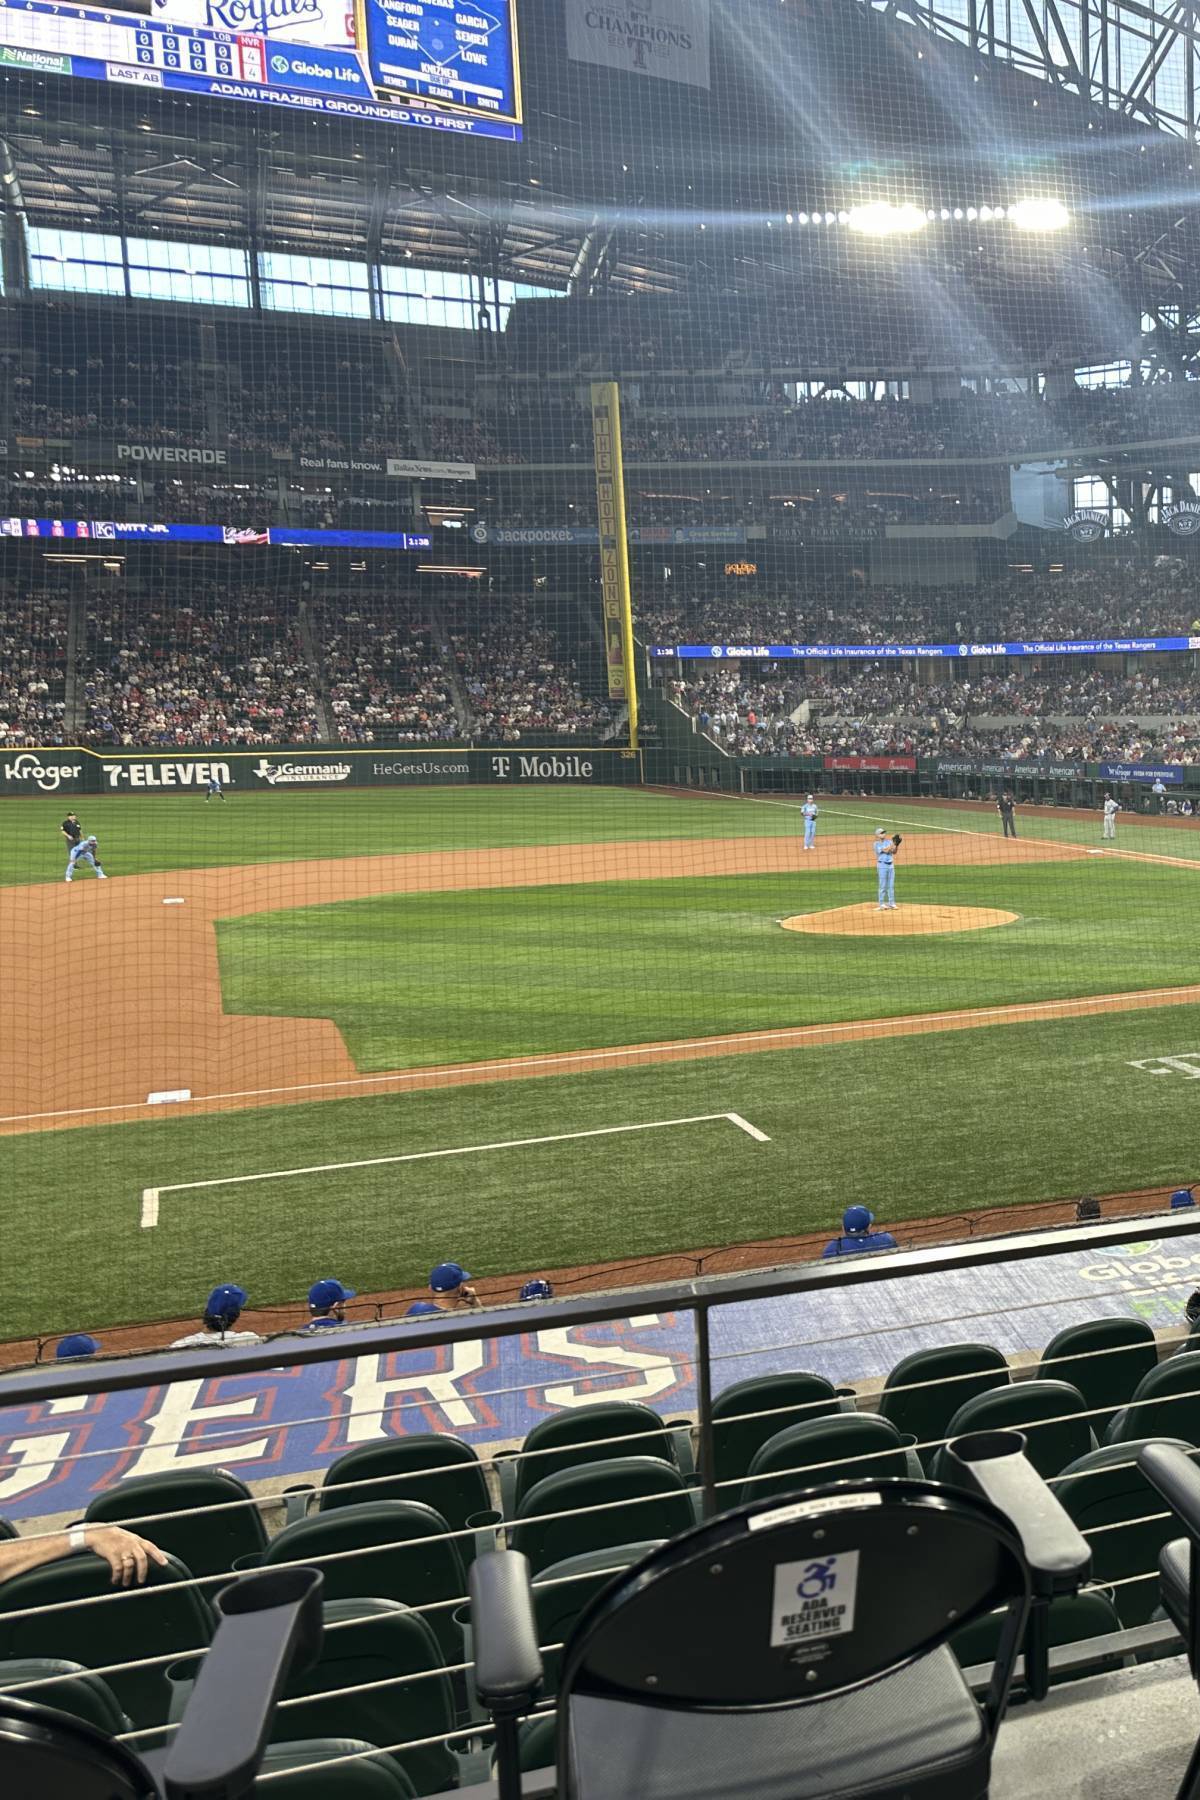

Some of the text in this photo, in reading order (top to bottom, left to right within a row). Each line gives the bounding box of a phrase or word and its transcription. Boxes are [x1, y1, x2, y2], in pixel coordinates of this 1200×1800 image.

[386, 15, 420, 32] SEAGER
[455, 13, 488, 30] GARCIA
[140, 20, 147, 28] R
[166, 24, 173, 33] H
[193, 29, 199, 37] E
[213, 32, 231, 42] LOB
[585, 11, 692, 50] CHAMPIONS
[388, 34, 418, 51] DURAN
[16, 51, 64, 66] National
[461, 50, 488, 66] LOWE
[110, 68, 159, 83] LAST AB
[291, 60, 360, 83] Globe Life
[210, 82, 474, 130] ADAM FRAZIER GROUNDED TO FIRST
[117, 444, 227, 465] POWERADE
[300, 457, 382, 471] Real fans know.
[1161, 504, 1178, 520] JACK
[115, 522, 147, 532] WITT
[149, 524, 169, 533] JR.
[726, 647, 769, 656] Globe Life
[971, 645, 1006, 655] Globe Life
[5, 754, 81, 789] Kroger
[283, 762, 351, 776] Germania
[373, 762, 469, 776] HeGetsUs.com
[492, 756, 593, 777] T Mobile
[937, 762, 971, 771] American
[1015, 765, 1039, 774] American
[287, 774, 339, 782] INSURANCE
[801, 1597, 828, 1612] ADA
[781, 1604, 846, 1627] RESERVED
[786, 1616, 840, 1637] SEATING
